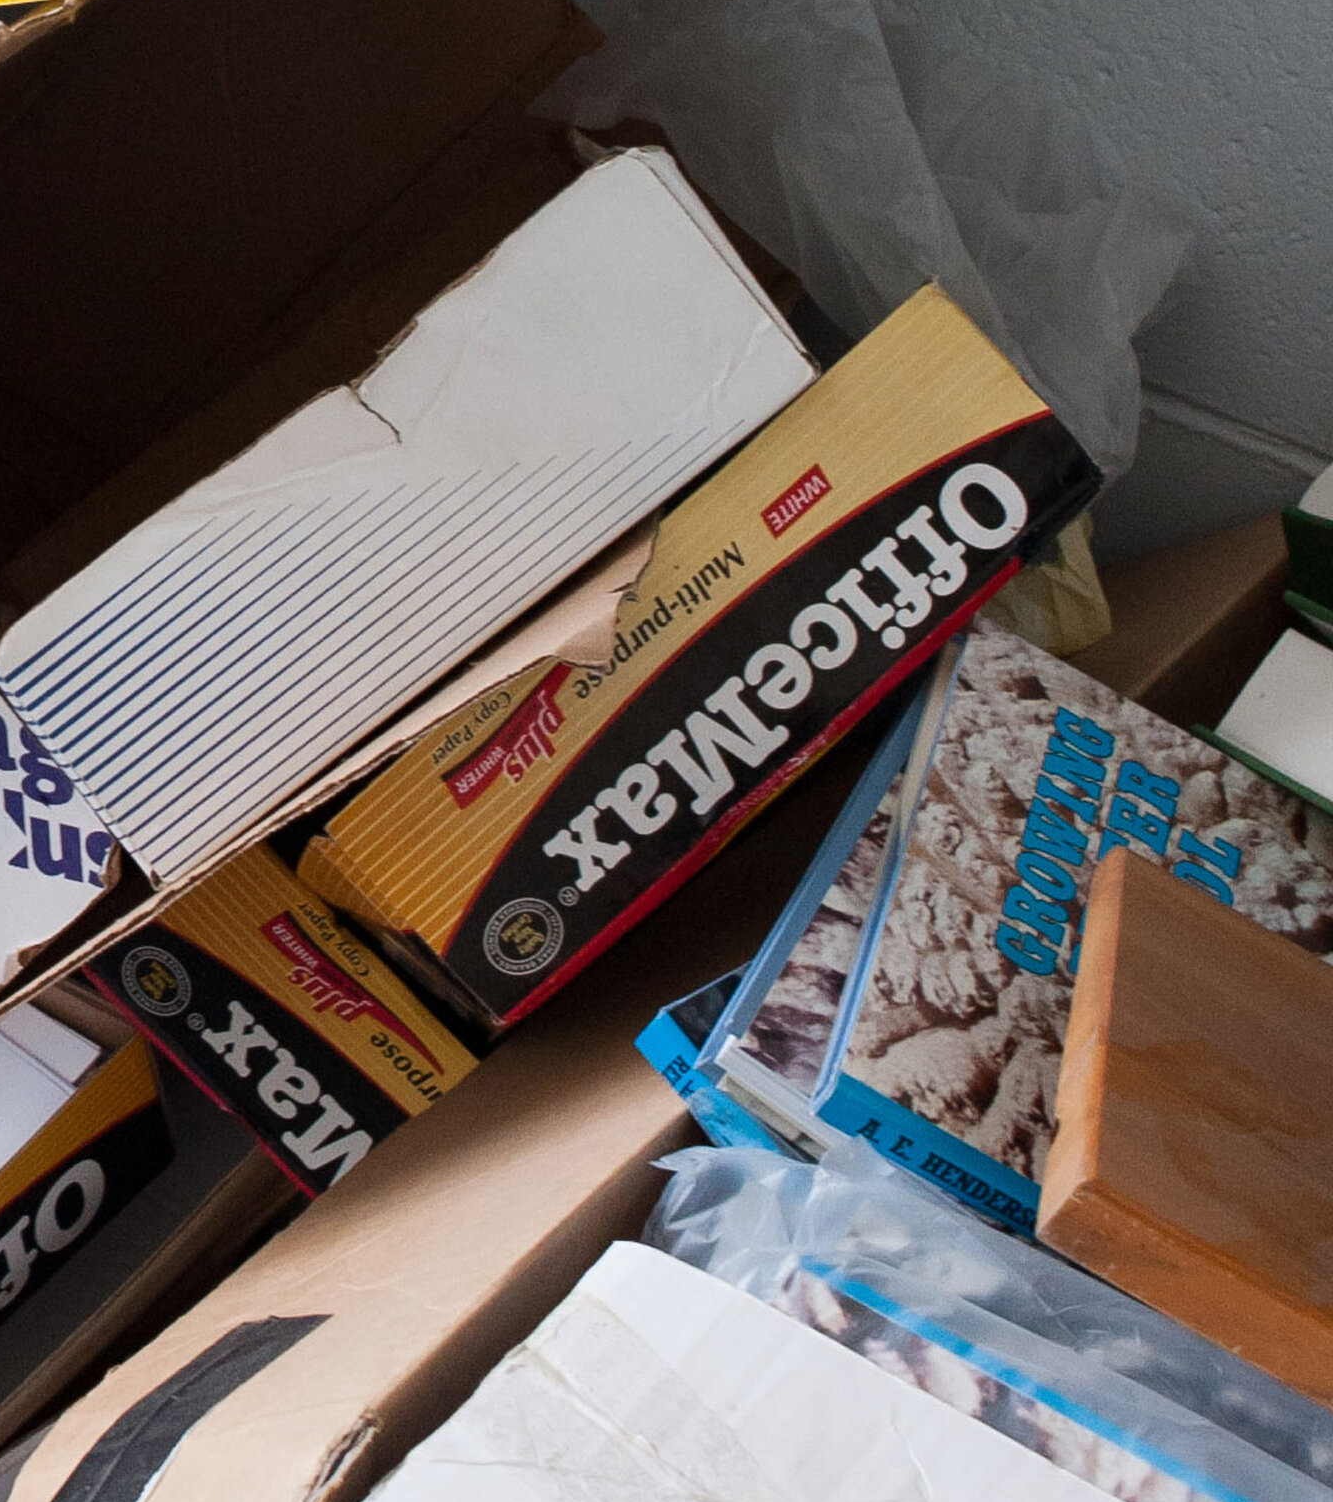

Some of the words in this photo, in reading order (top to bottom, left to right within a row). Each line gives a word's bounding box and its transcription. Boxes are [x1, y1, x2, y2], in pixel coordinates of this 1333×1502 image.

[766, 469, 829, 534] WHITE
[473, 691, 511, 723] Copy
[542, 463, 1028, 893] OfficeMax
[433, 725, 473, 764] Paper
[501, 686, 568, 786] plus
[455, 745, 508, 798] WHITER
[997, 706, 1116, 977] GROWING
[270, 917, 320, 975] WHITER
[298, 895, 335, 941] Paper
[282, 941, 375, 1039] plus
[334, 935, 368, 985] Copy
[918, 1148, 1041, 1232] HENDERS
